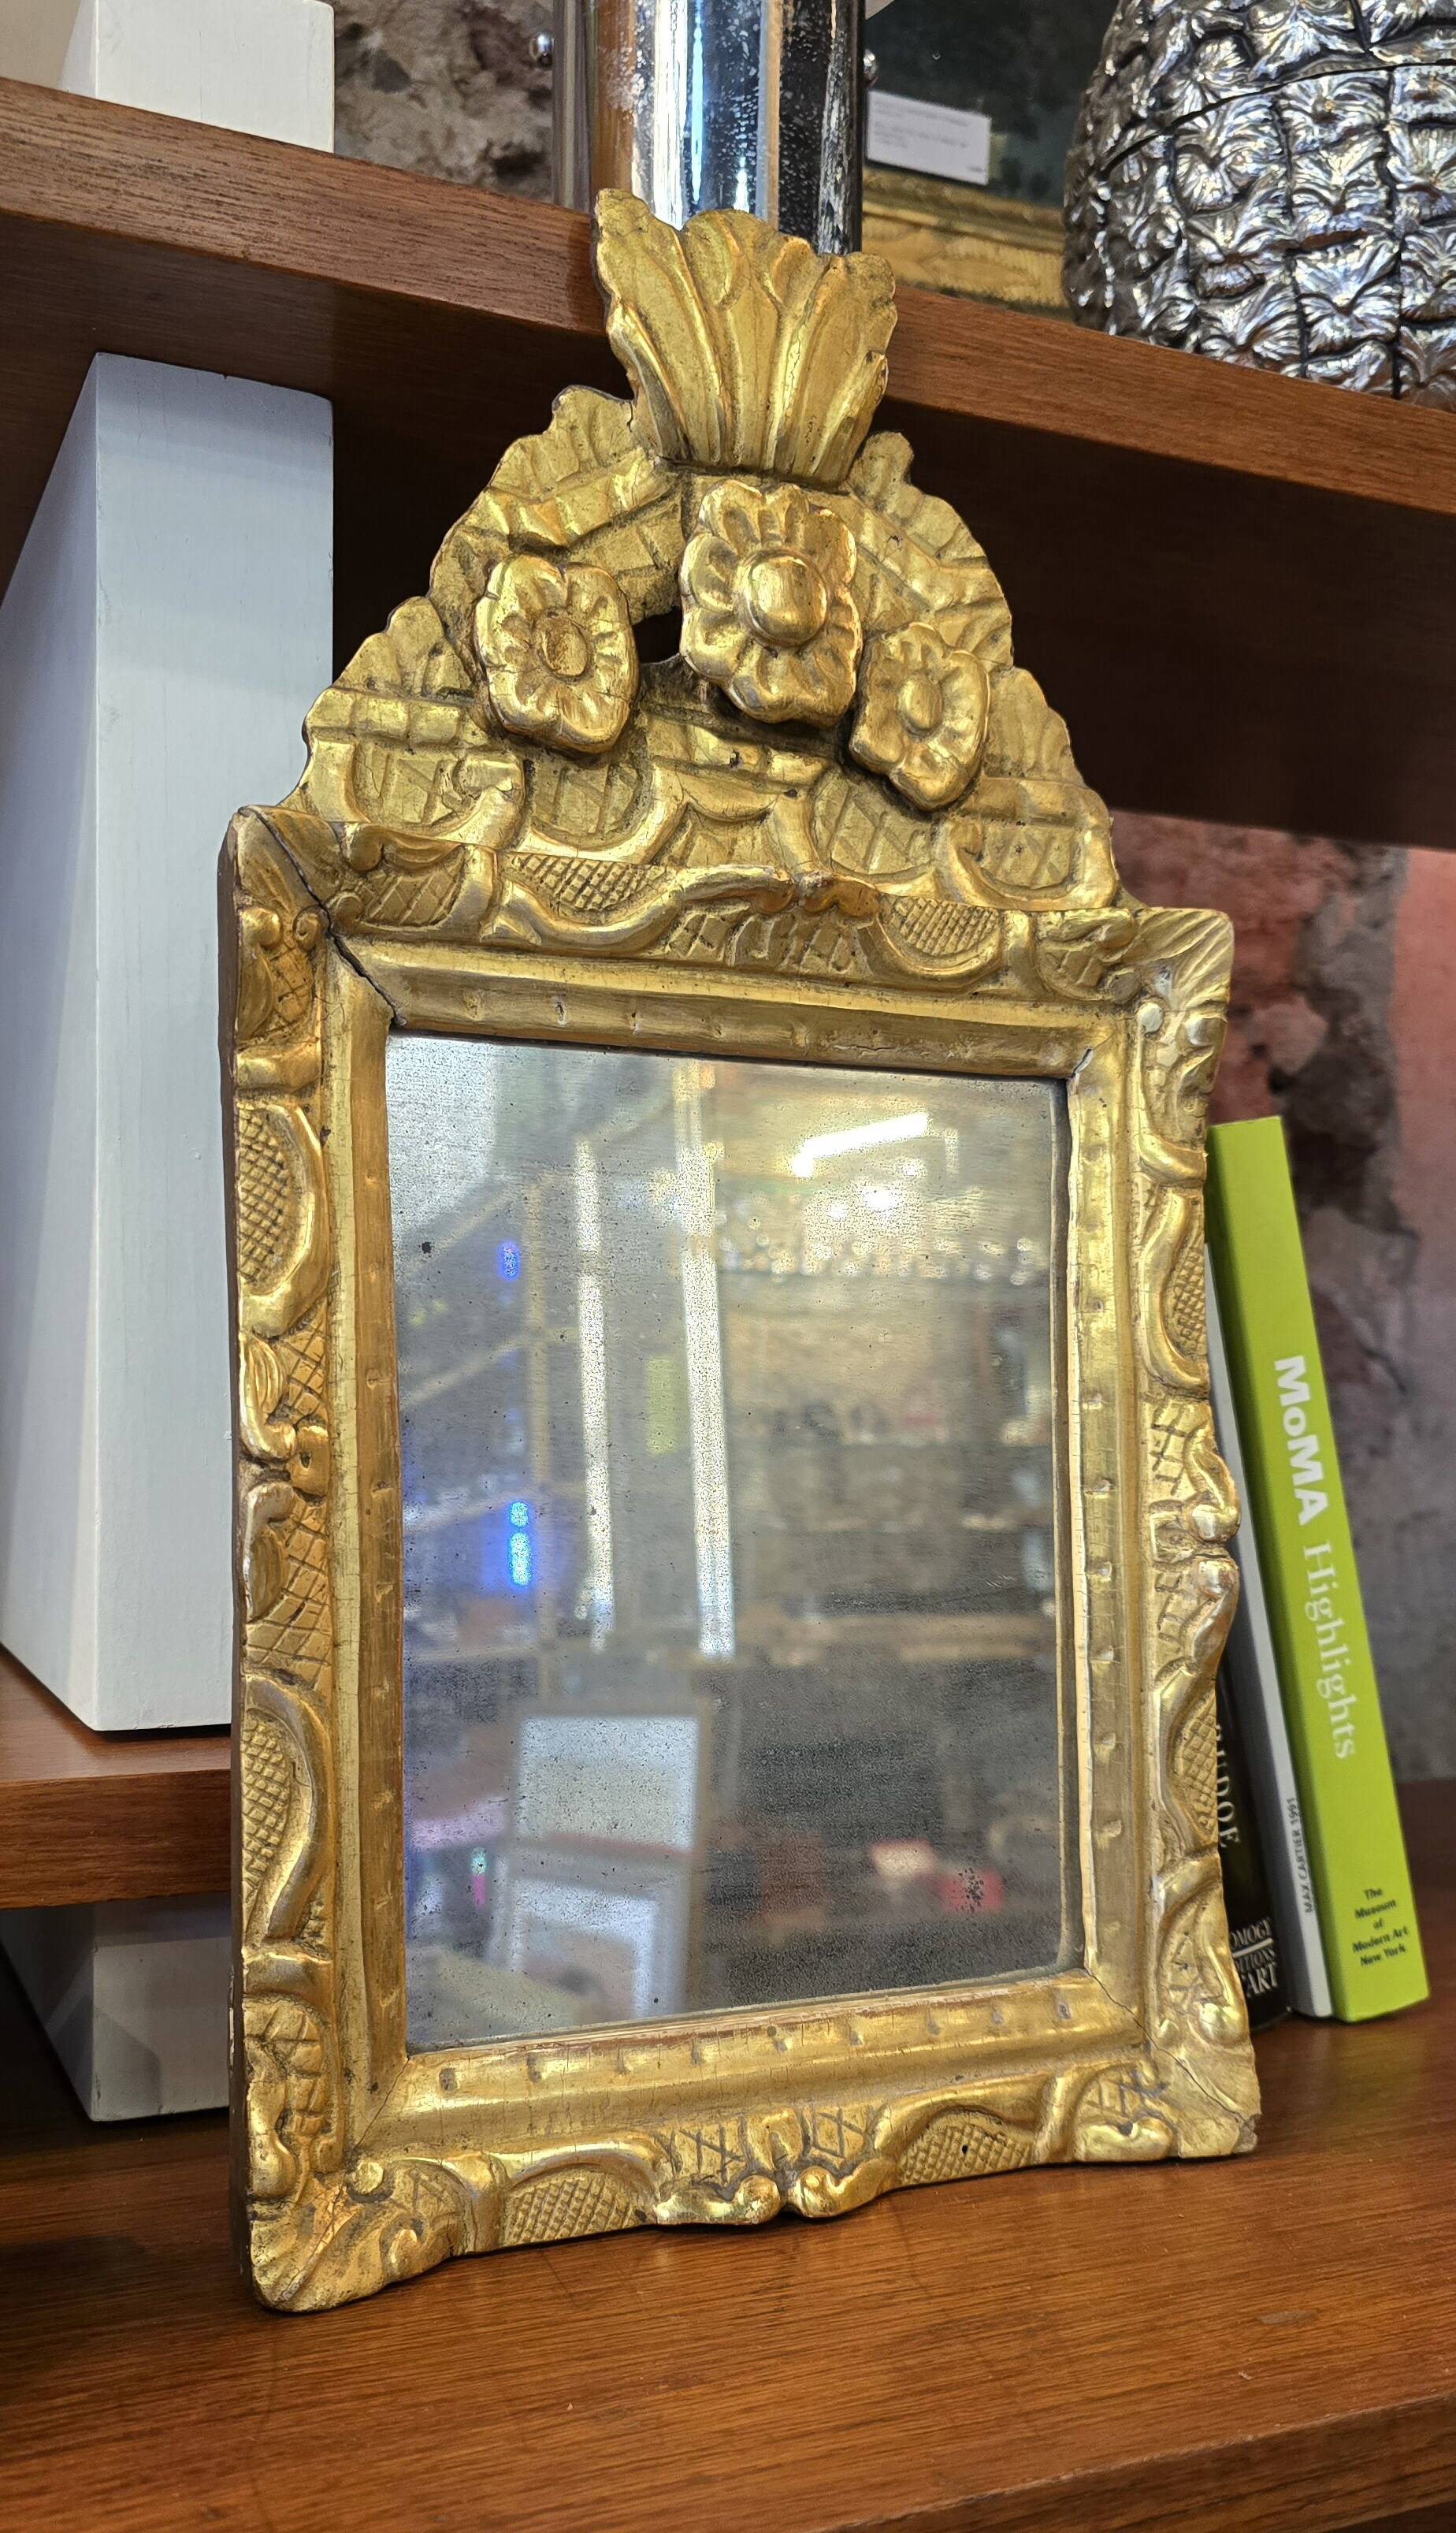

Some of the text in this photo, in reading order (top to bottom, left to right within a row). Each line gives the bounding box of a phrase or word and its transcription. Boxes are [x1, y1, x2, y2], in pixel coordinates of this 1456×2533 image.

[1274, 1356, 1357, 1759] MoMA Highlights
[1364, 1888, 1383, 1900] The
[1355, 1899, 1396, 1918] Museum
[1373, 1917, 1383, 1929] of
[1353, 1926, 1408, 1953] Modern Art
[1361, 1943, 1406, 1967] New York
